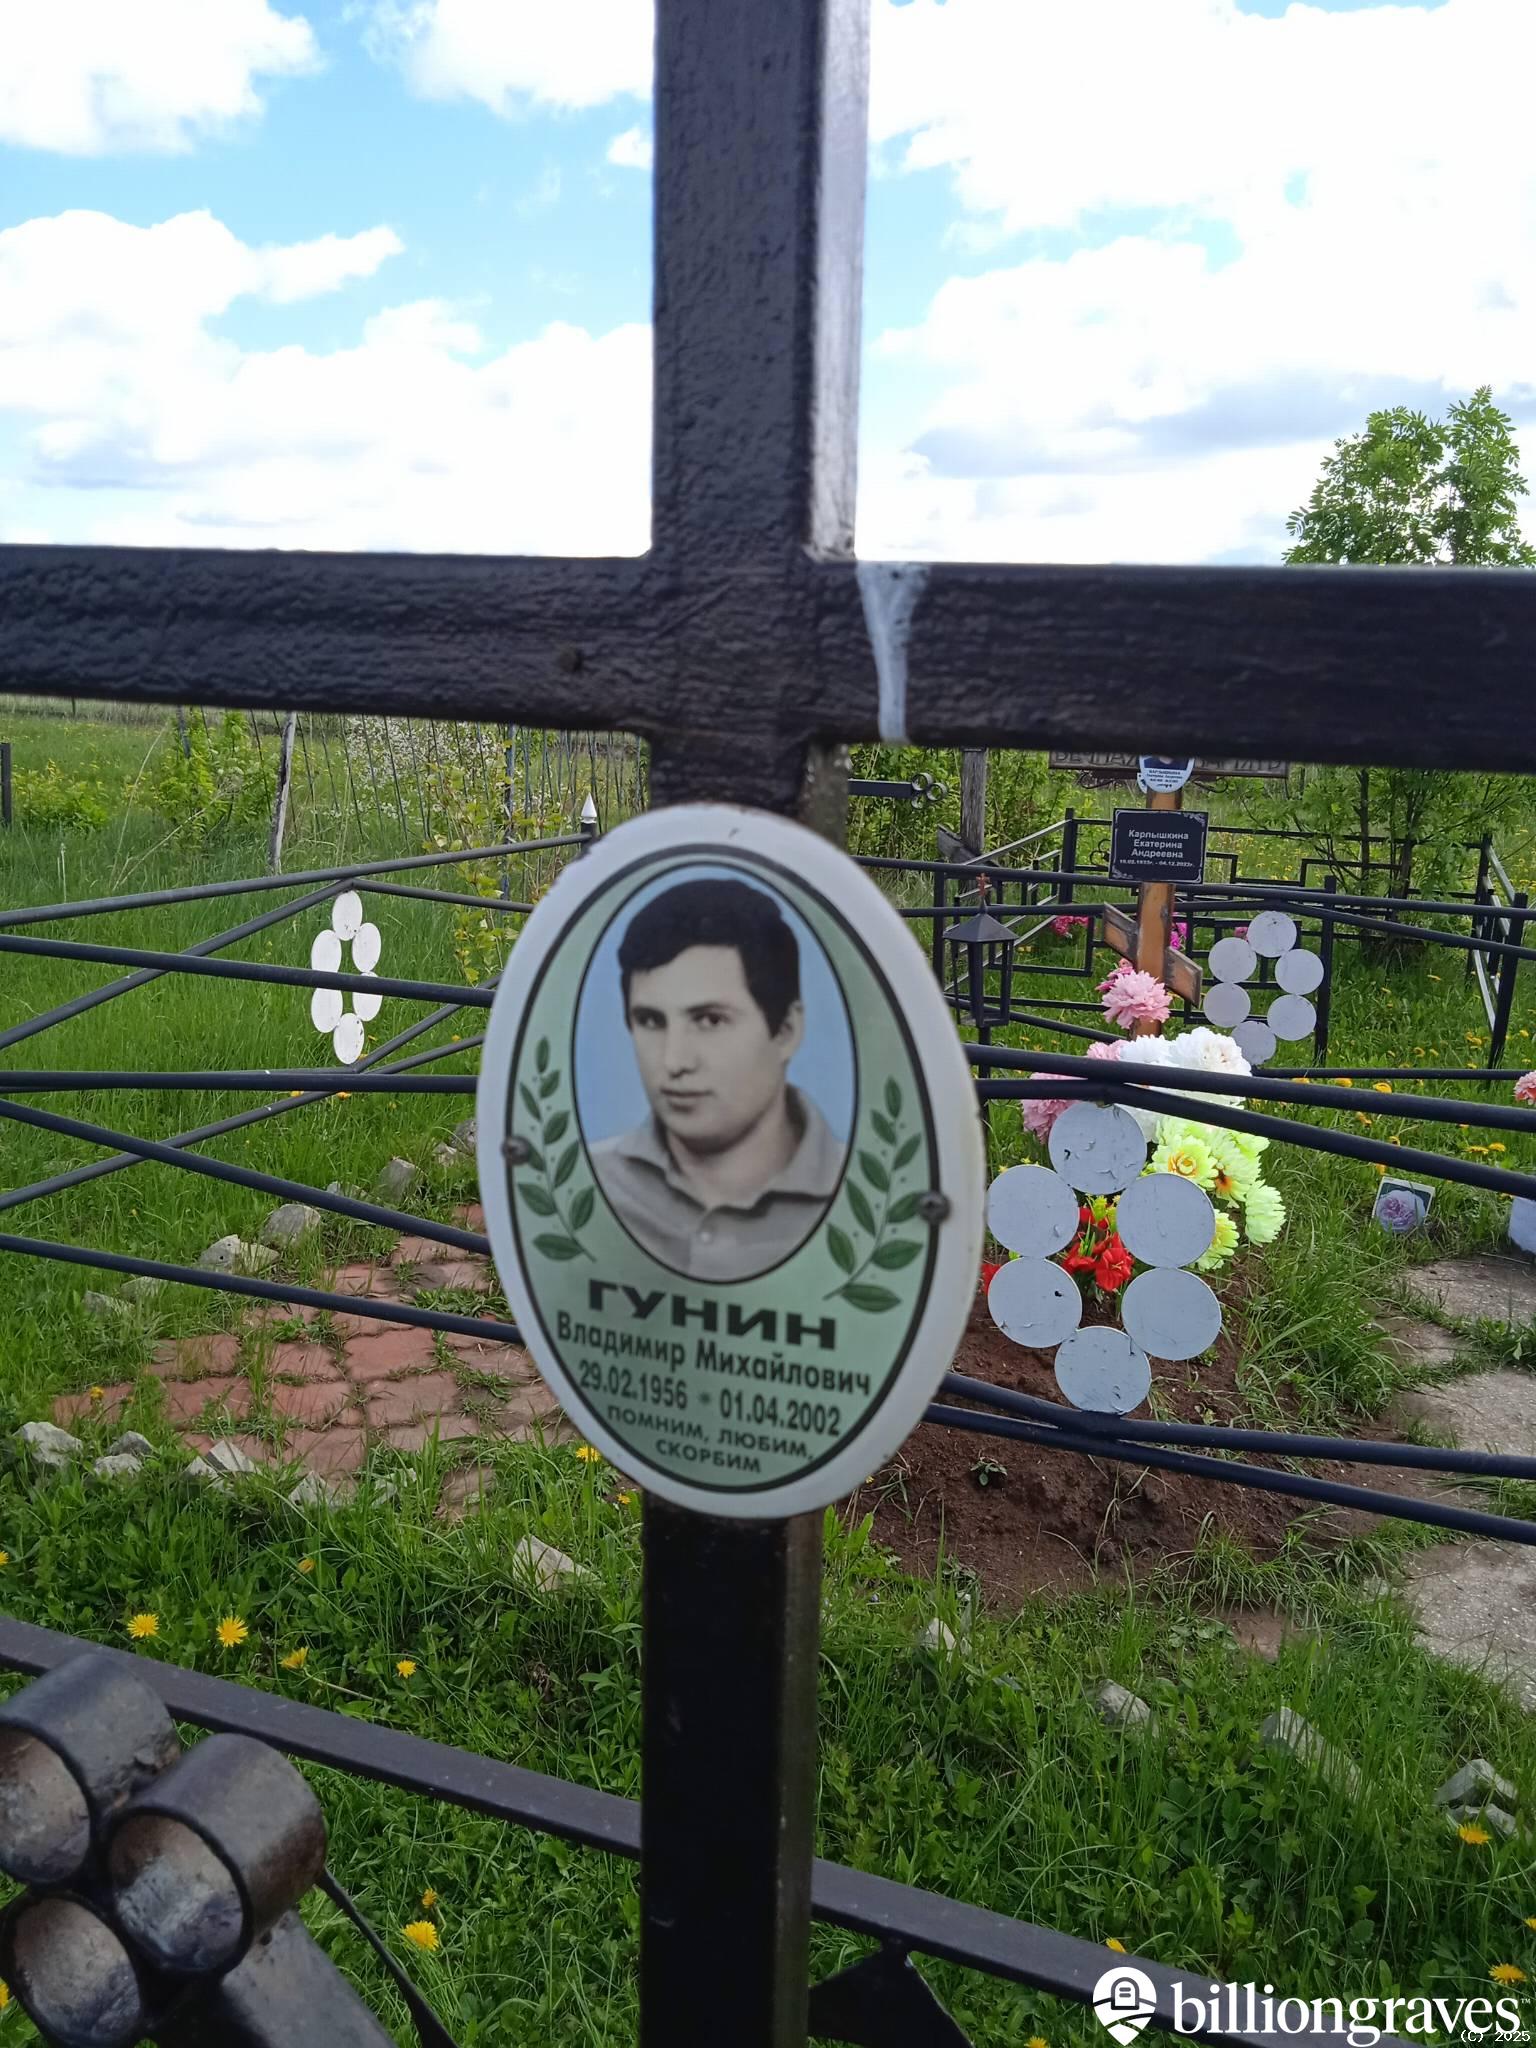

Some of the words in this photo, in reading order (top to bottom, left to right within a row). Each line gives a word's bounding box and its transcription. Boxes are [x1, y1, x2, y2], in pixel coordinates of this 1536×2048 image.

[1130, 848, 1184, 859] Андреевна
[1133, 838, 1183, 849] Екатерина
[589, 1278, 837, 1350] ГУНИН
[556, 1310, 686, 1372] Владимир
[695, 1338, 872, 1397] Михайлович
[578, 1358, 689, 1411] 29.02.1956
[719, 1387, 842, 1437] 01.04.2002
[607, 1404, 711, 1443] ПОМНИМ,
[717, 1427, 816, 1462] ЛЮБИМ,
[655, 1438, 763, 1474] СКОРБИМ
